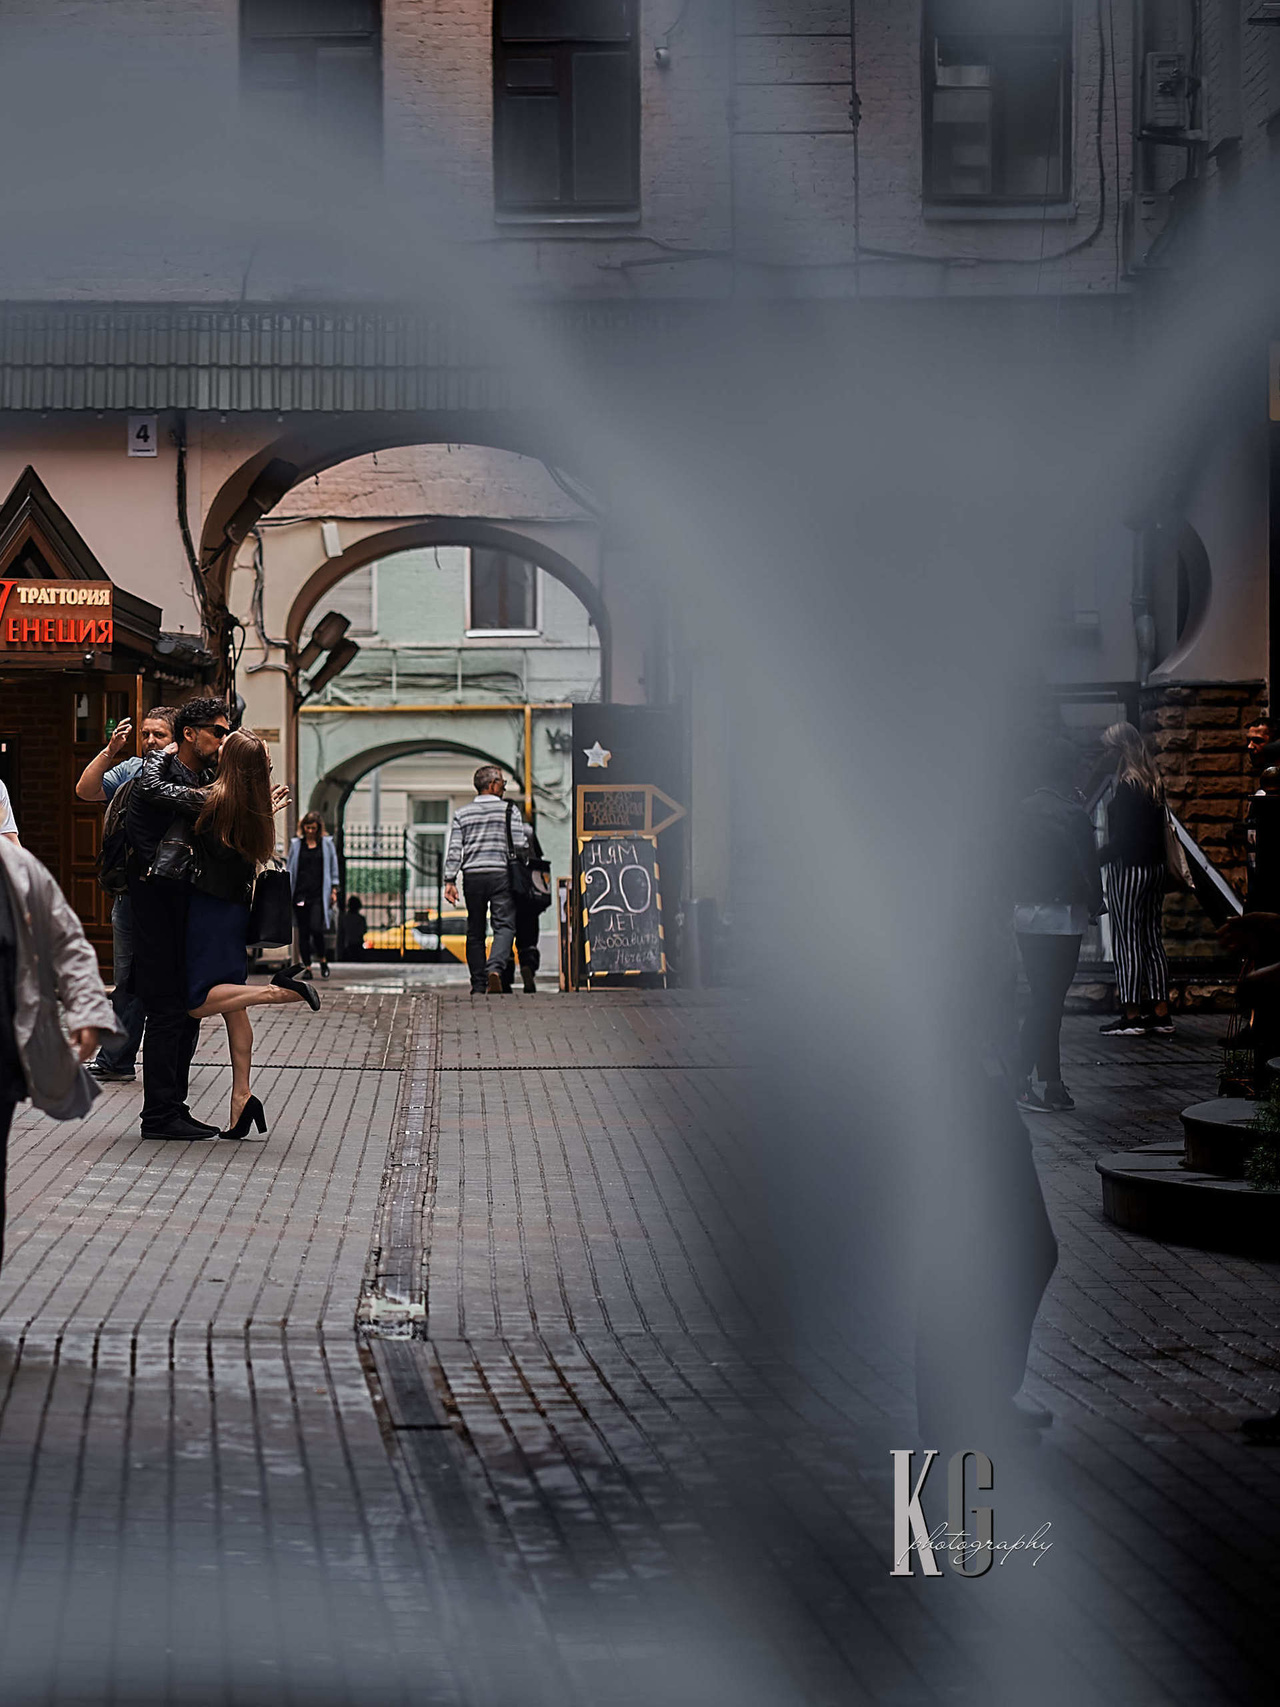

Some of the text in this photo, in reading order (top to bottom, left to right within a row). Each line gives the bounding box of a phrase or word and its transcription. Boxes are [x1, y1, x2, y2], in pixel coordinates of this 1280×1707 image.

[136, 424, 150, 443] 4
[17, 587, 111, 606] ТРАТТОРИЯ
[589, 843, 639, 865] НЯМ
[585, 864, 651, 914] 20
[605, 913, 638, 932] ЛЕТ
